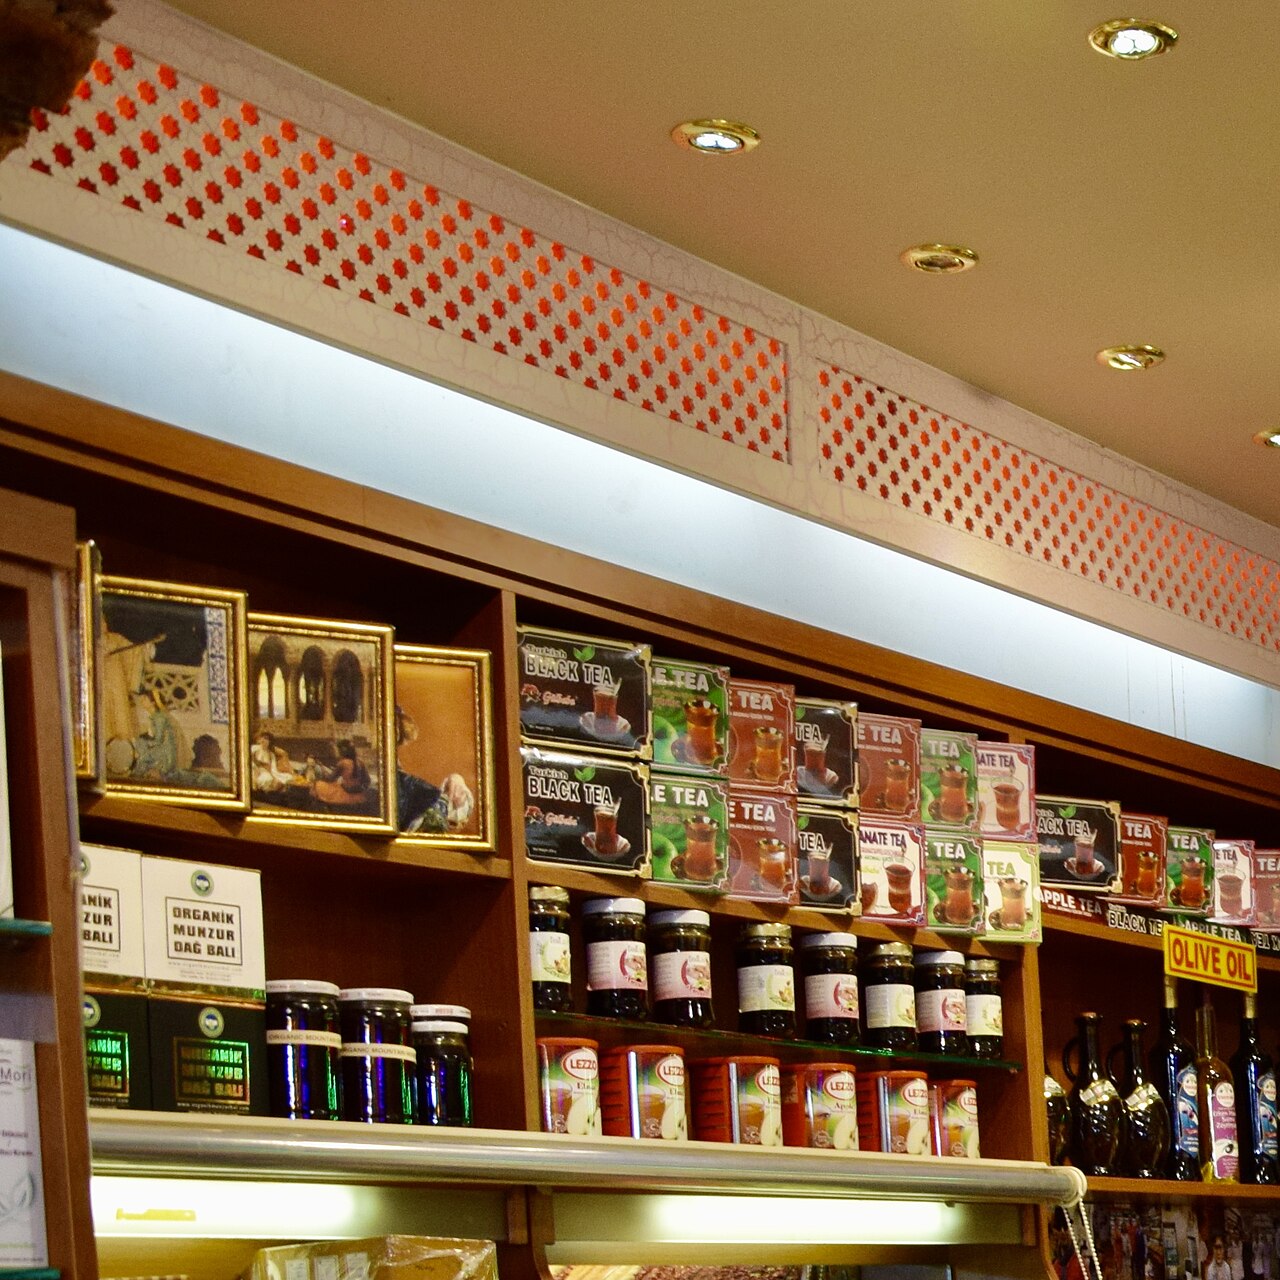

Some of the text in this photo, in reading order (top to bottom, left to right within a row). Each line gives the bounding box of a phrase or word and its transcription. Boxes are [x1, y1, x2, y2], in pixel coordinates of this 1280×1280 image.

[525, 654, 614, 687] BLACK TEA
[673, 671, 709, 692] TEA
[737, 691, 774, 711] TEA
[795, 723, 822, 743] TEA
[871, 726, 903, 745] TEA
[929, 740, 960, 758] TEA
[999, 754, 1016, 769] TEA
[528, 766, 568, 781] Turkish
[528, 776, 614, 807] BLACK TEA
[672, 787, 709, 807] TEA
[743, 804, 776, 822] TEA
[1037, 817, 1091, 837] ACK TEA
[1125, 822, 1152, 839] TEA
[800, 832, 825, 851] TEA
[890, 833, 907, 849] TEA
[1171, 834, 1199, 851] TEA
[933, 842, 966, 860] TEA
[987, 861, 1016, 877] TEA
[1037, 890, 1102, 915] APPLE TEA
[173, 907, 234, 924] ORGANİK
[1108, 909, 1146, 934] BLACK
[173, 924, 234, 941] MUNZUR
[1221, 925, 1242, 943] TEA
[174, 940, 236, 958] DAĞ BALI
[1172, 938, 1252, 981] OLIVE OIL
[570, 1059, 597, 1070] LEZZO
[830, 1082, 854, 1092] LEZZO
